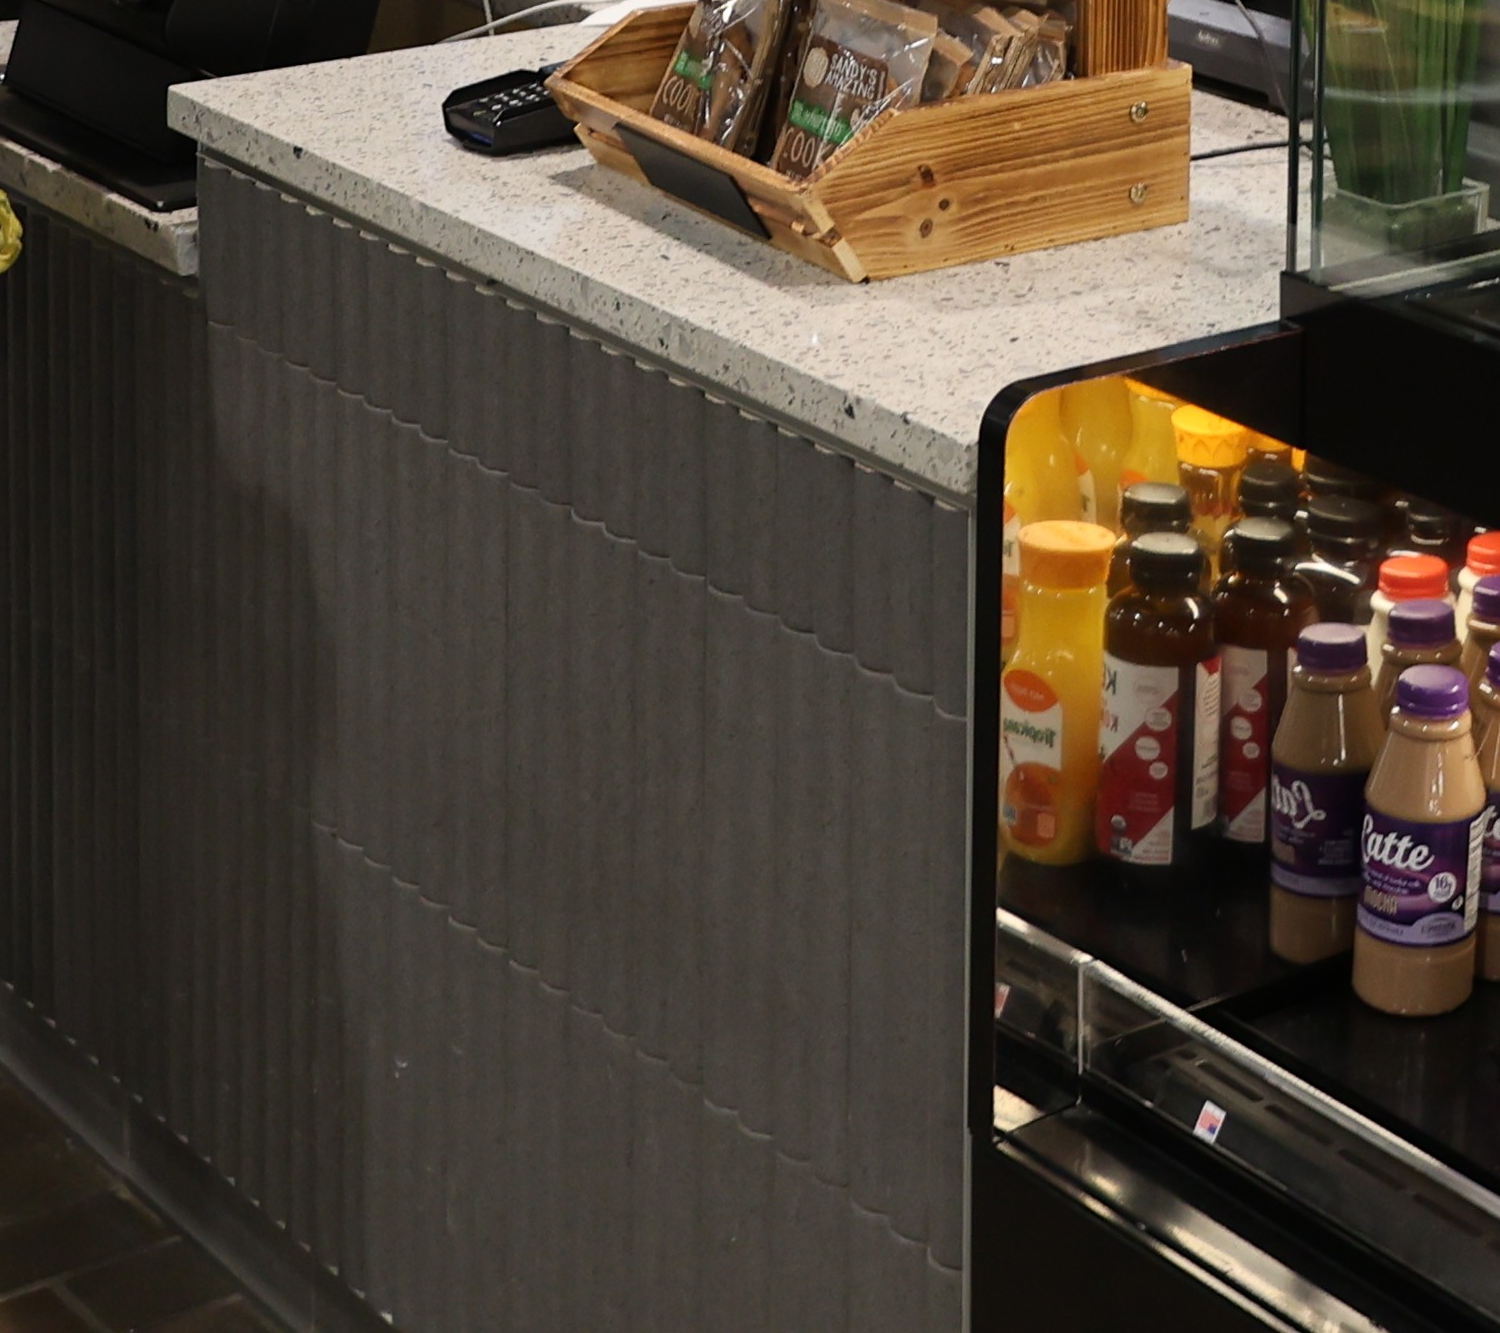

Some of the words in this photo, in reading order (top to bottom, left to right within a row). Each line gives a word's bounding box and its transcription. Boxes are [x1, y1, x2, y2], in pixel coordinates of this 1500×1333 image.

[831, 53, 878, 83] SANDY'S
[825, 70, 876, 99] AMAZING
[1362, 813, 1435, 872] Latte
